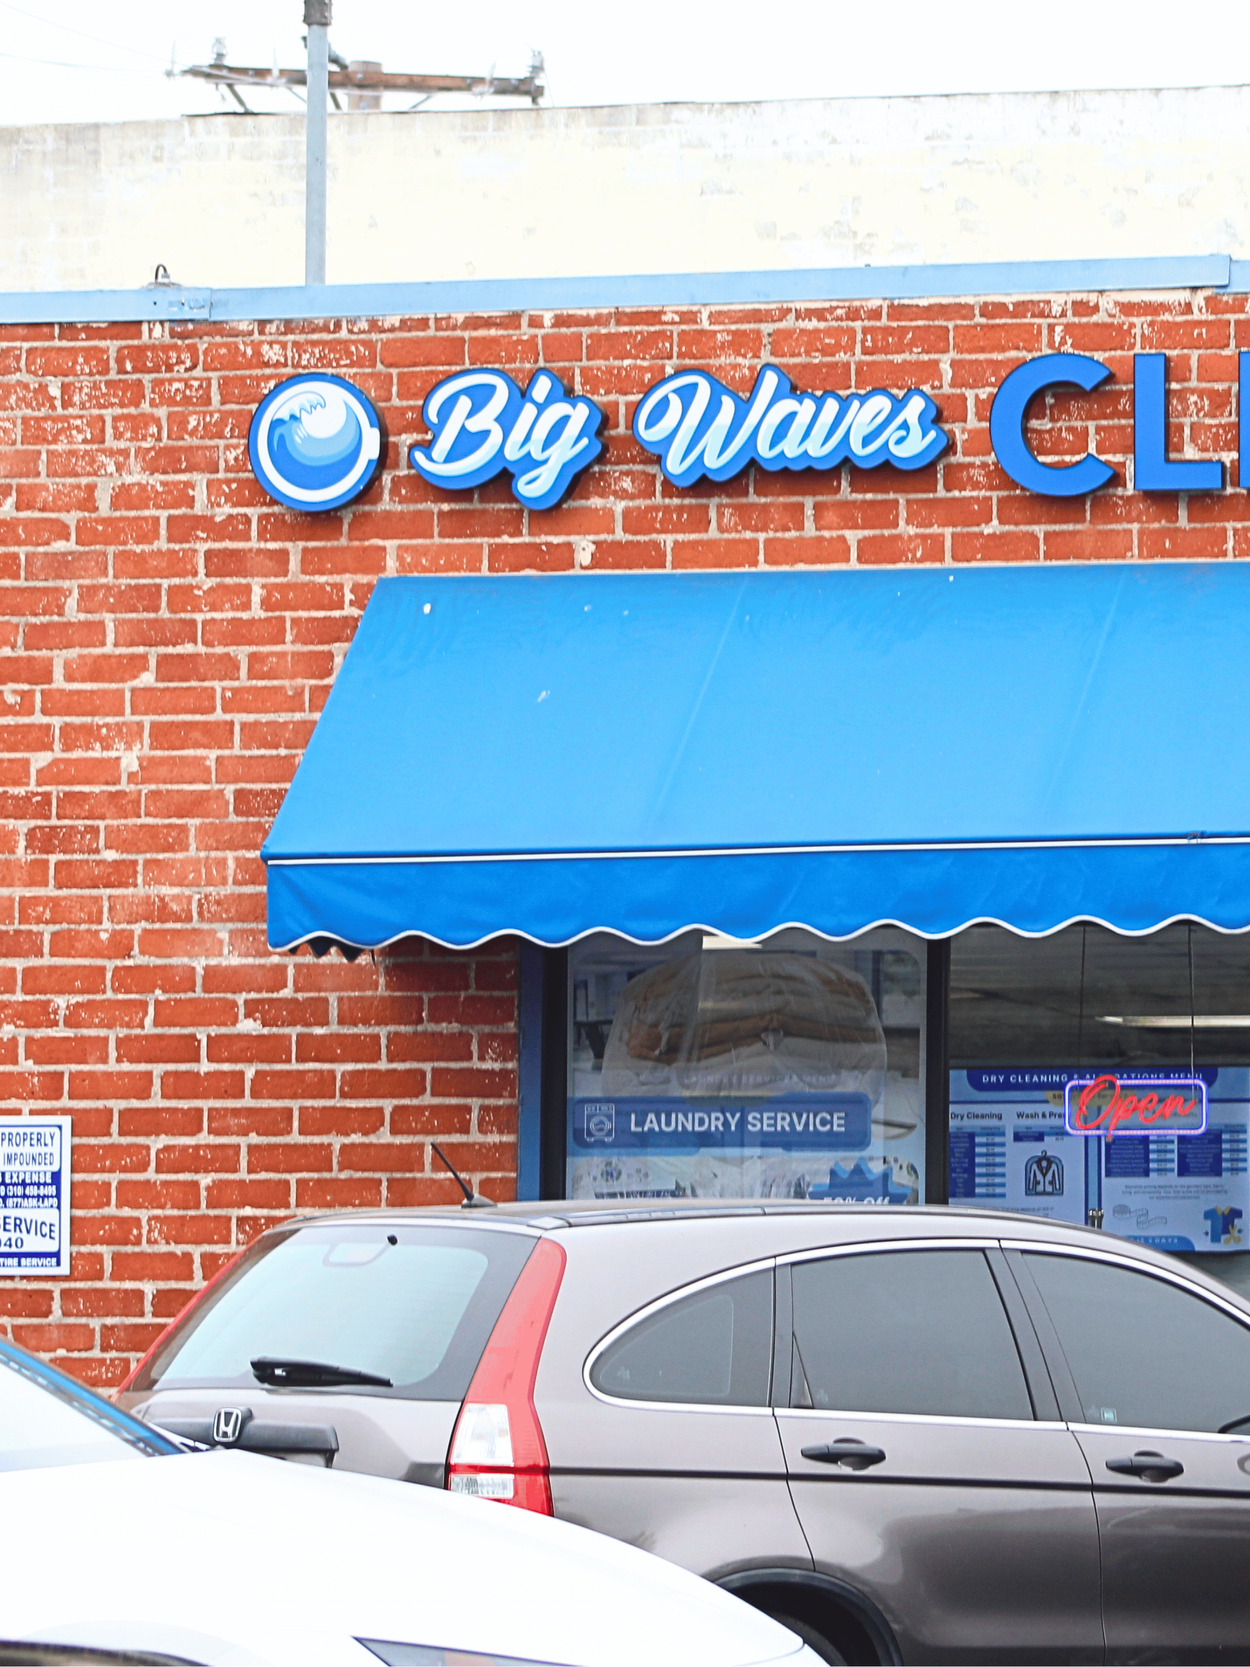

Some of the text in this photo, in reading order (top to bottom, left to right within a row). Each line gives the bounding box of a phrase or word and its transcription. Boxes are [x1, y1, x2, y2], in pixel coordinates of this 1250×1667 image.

[411, 369, 591, 498] Big
[635, 366, 937, 477] Waves
[982, 1073, 1005, 1084] DRY
[1010, 1073, 1068, 1083] CLEANING
[1016, 1111, 1040, 1120] Wash
[1042, 1111, 1047, 1120] &
[1075, 1074, 1197, 1142] Open
[630, 1112, 846, 1132] LAUNDRY SERVICE
[950, 1111, 1003, 1121] Dry Cleaning
[1, 1131, 56, 1148] PROPERLY
[3, 1151, 55, 1166] IMPOUNDED
[5, 1171, 53, 1184] EXPENSE
[0, 1213, 56, 1241] ERVICE
[21, 1257, 57, 1267] SERVICE
